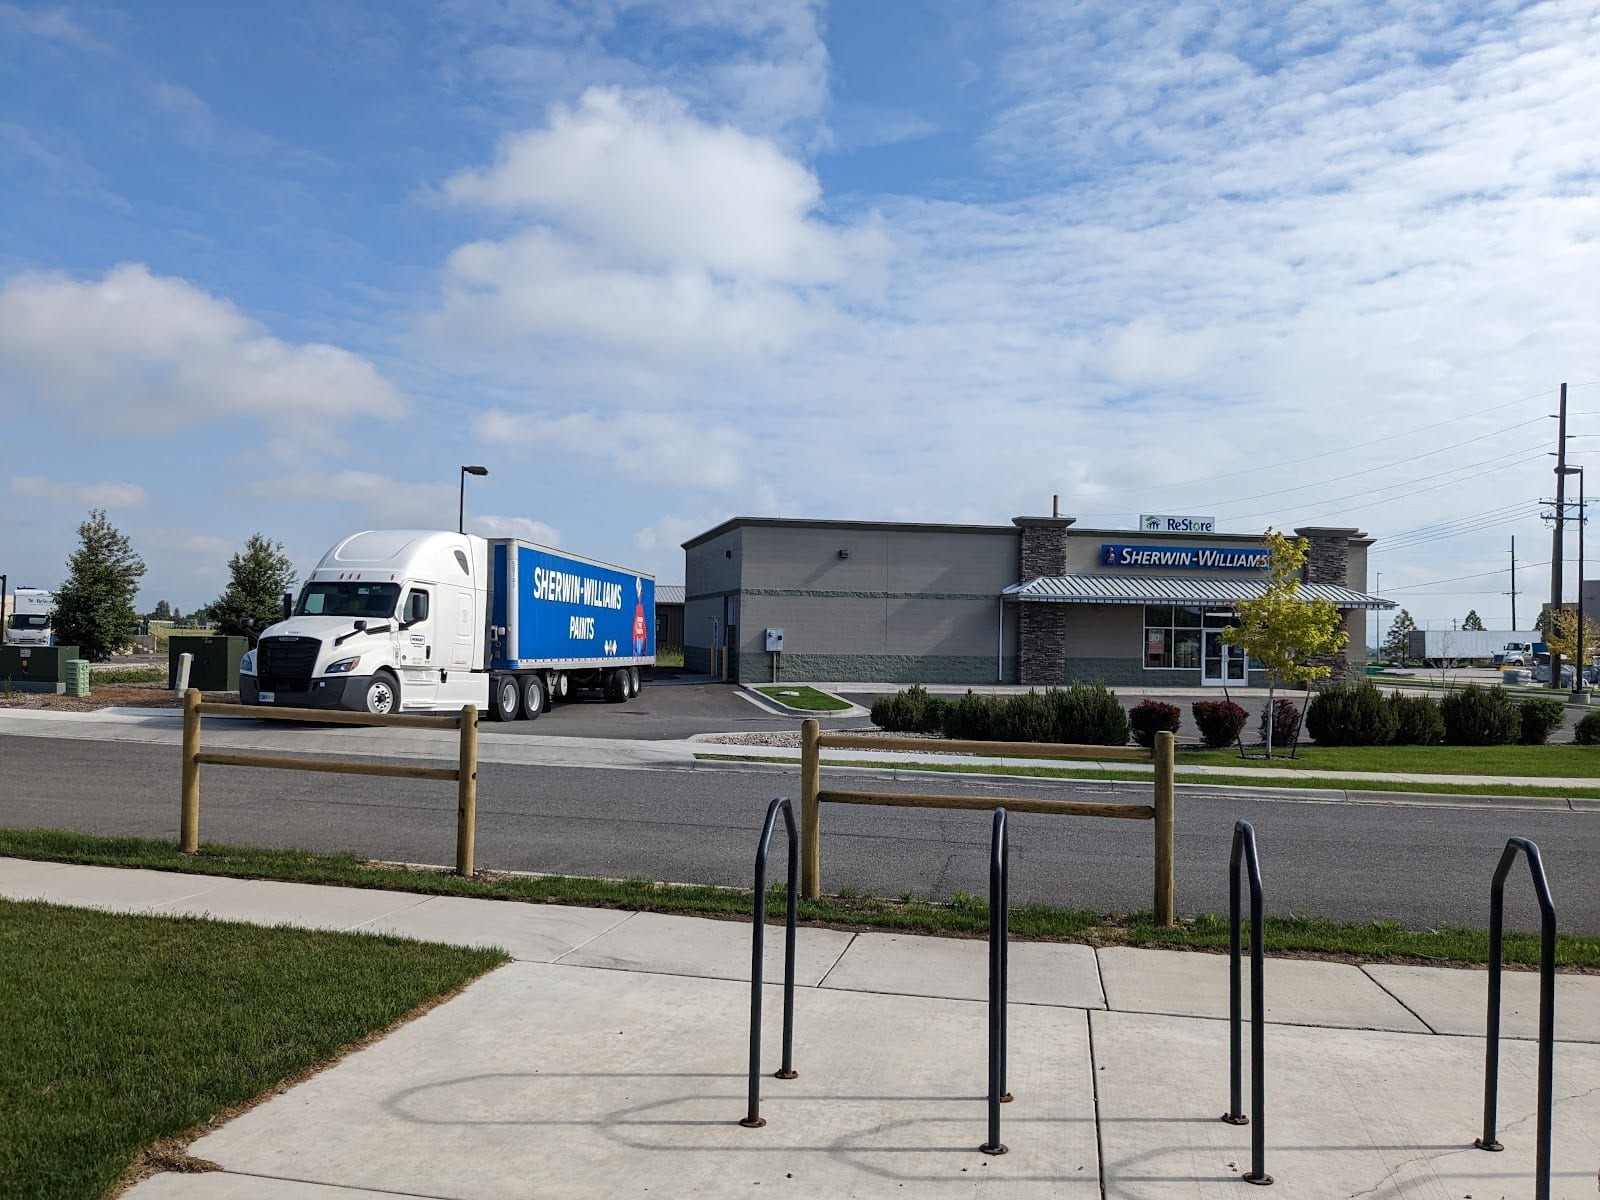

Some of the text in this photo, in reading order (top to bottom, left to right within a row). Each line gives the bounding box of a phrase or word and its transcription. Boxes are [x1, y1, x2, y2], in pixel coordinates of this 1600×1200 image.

[1167, 518, 1212, 531] ReStore
[533, 566, 622, 610] SHERWIN-WILLIAMS
[569, 615, 595, 640] PAINTS
